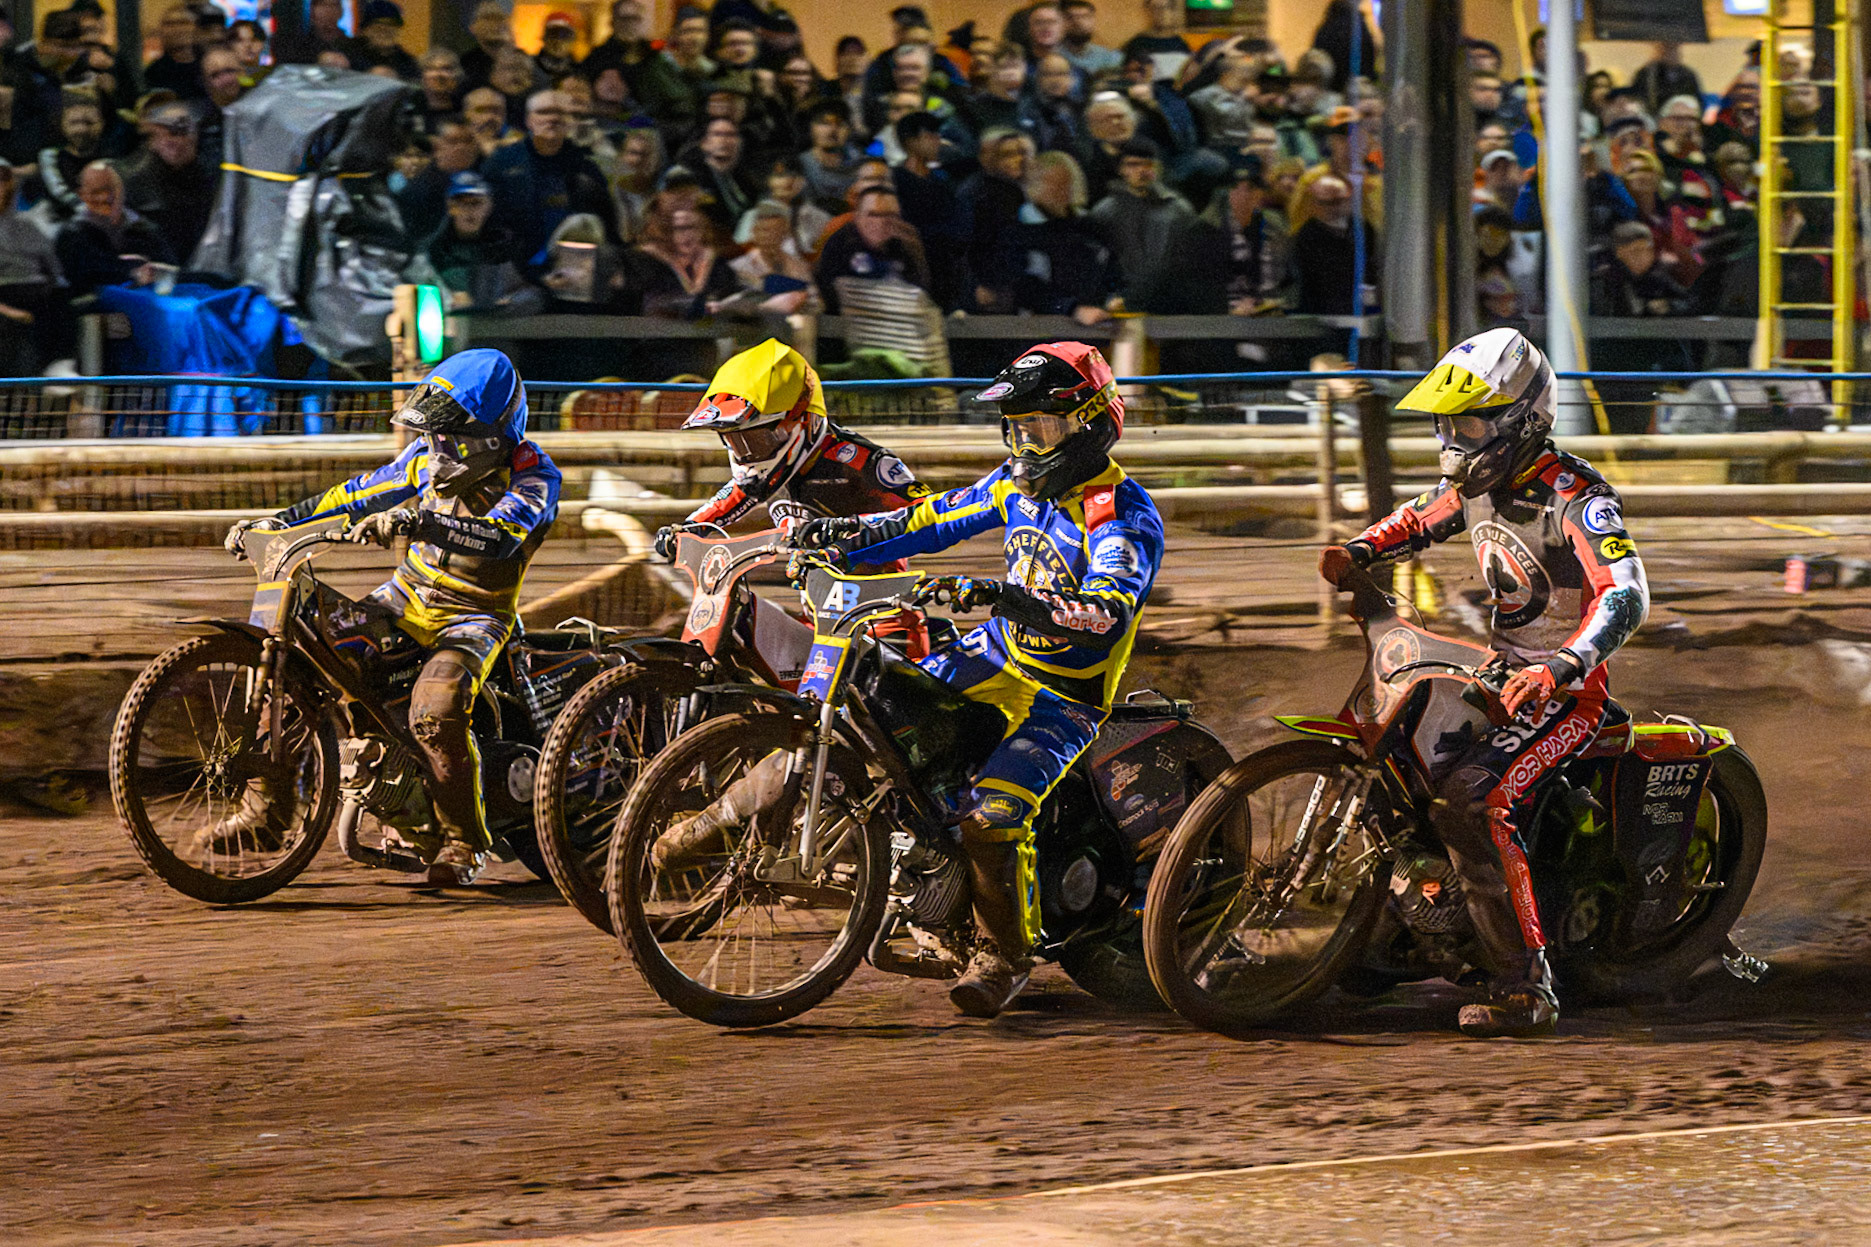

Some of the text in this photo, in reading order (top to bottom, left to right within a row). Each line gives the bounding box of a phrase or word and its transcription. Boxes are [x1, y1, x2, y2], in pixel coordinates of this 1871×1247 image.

[447, 529, 487, 551] Perkins
[1509, 544, 1538, 575] ACES
[1052, 609, 1108, 634] Clarke
[1646, 763, 1700, 783] BRTS
[1644, 781, 1692, 799] Racing
